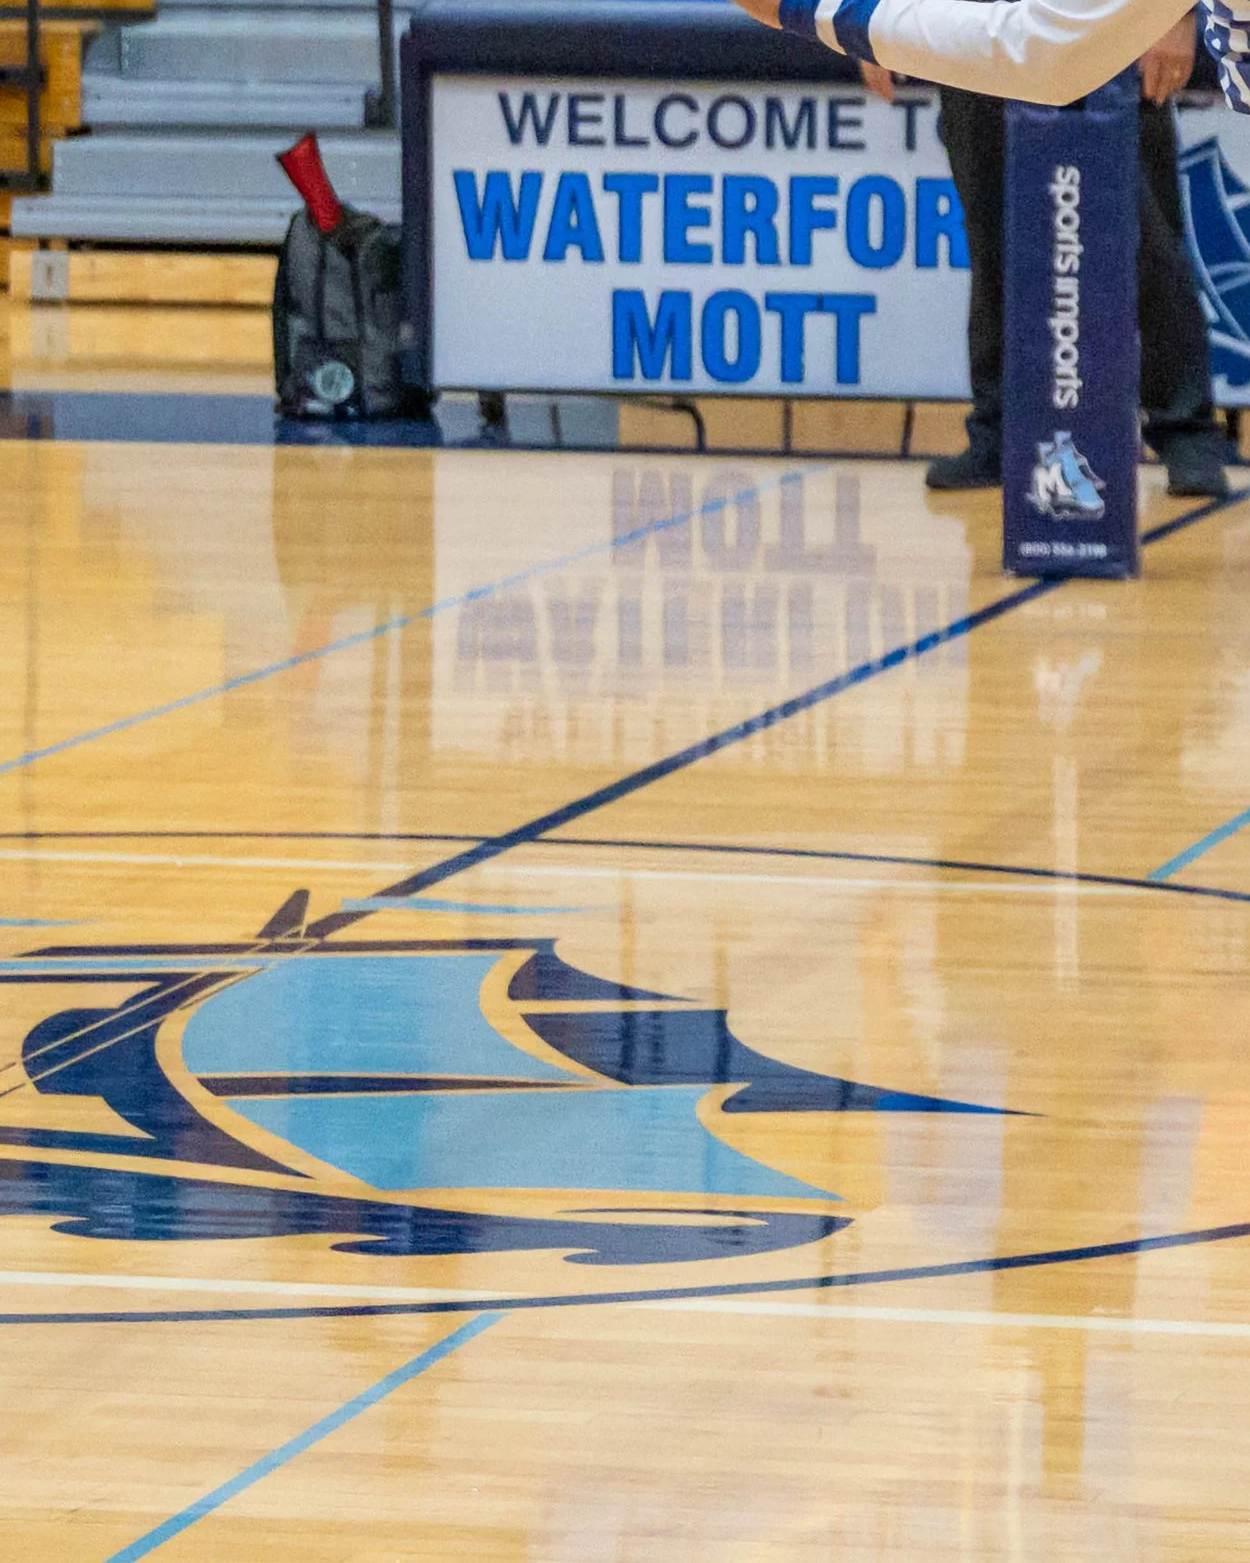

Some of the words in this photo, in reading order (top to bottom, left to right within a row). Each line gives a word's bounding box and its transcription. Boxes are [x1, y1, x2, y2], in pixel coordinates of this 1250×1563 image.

[498, 90, 868, 153] WELCOME
[891, 96, 944, 153] T
[611, 288, 877, 386] MOTT
